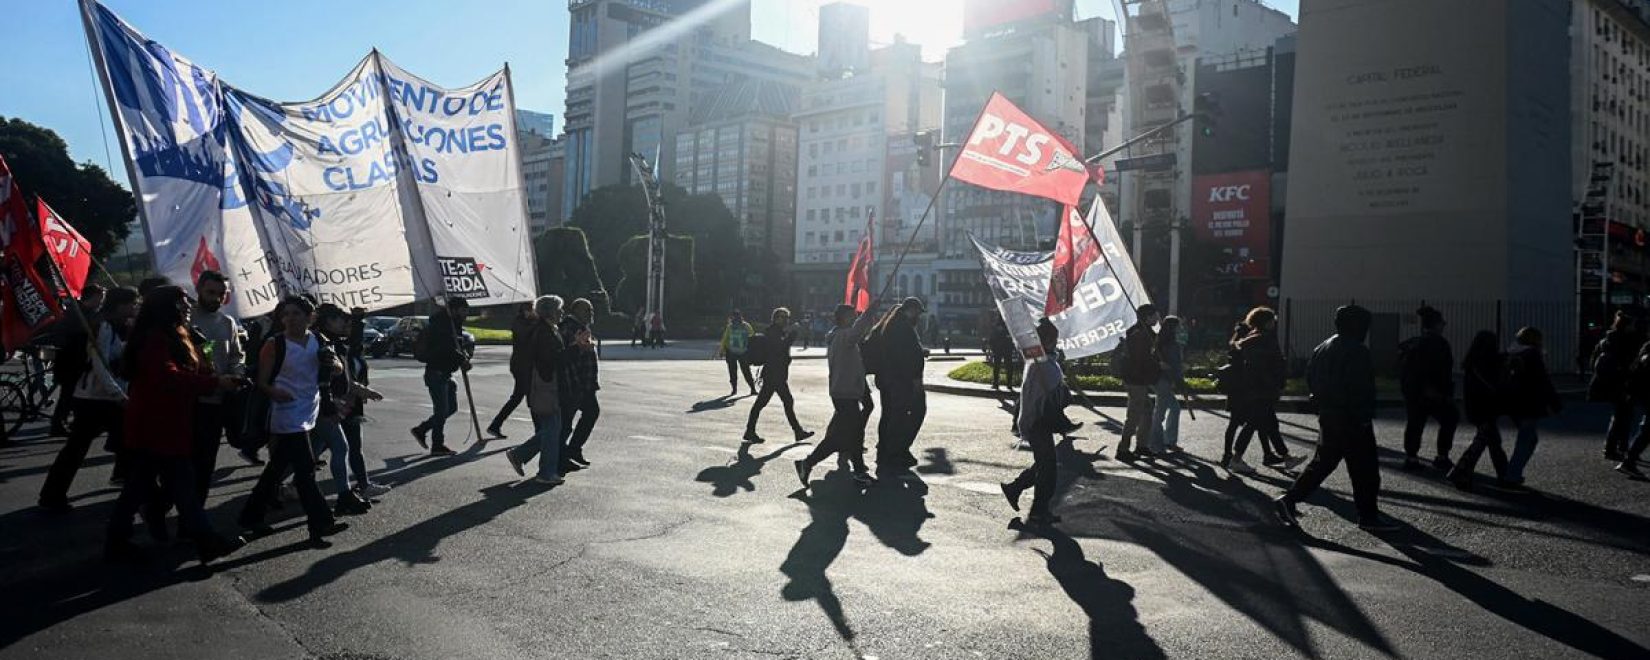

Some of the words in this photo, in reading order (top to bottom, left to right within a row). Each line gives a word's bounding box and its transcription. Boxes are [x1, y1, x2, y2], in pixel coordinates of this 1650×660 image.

[468, 84, 504, 116] DE
[970, 113, 1049, 165] PTS
[1209, 184, 1251, 202] KFC
